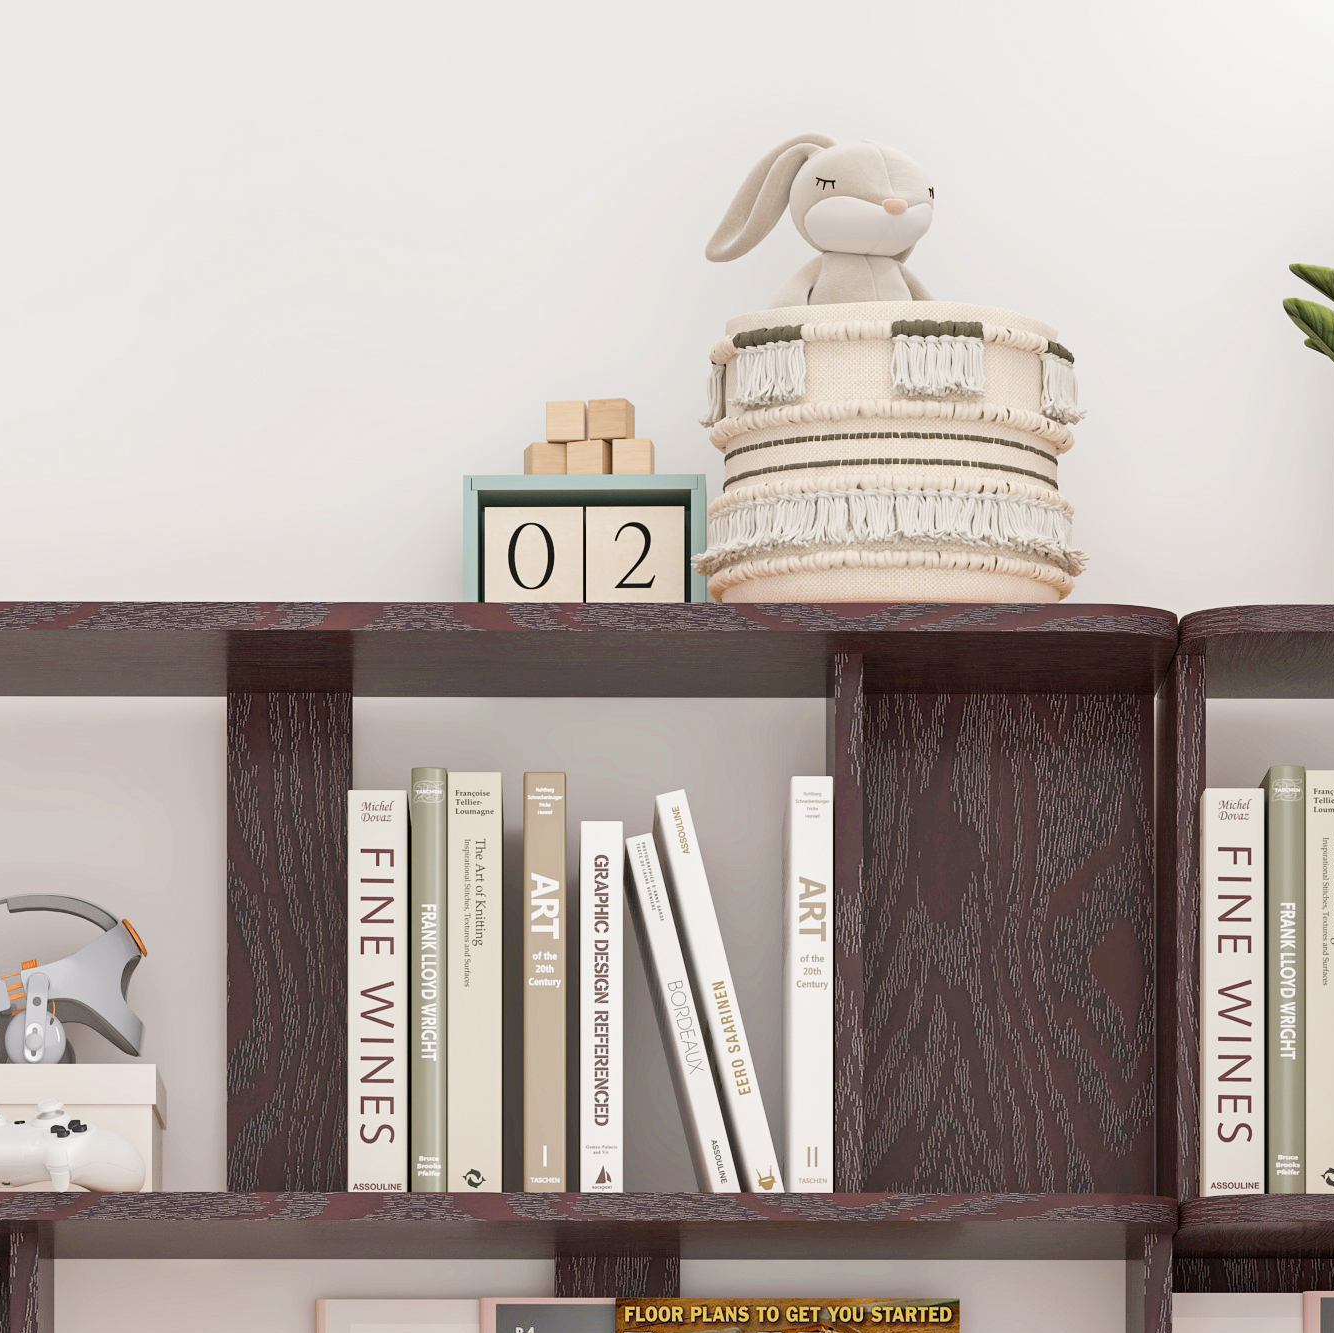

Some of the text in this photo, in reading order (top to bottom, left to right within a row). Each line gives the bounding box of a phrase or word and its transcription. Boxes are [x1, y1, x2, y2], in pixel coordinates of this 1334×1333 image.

[455, 789, 491, 798] Françoise
[360, 800, 395, 812] Michel
[455, 798, 483, 806] Tellier-
[360, 812, 392, 823] Dovaz
[455, 807, 495, 817] Loumagne
[671, 806, 690, 854] ASSOULINE
[471, 837, 487, 947] The Art of Knitting
[462, 839, 472, 988] Inspirational Stitches, Textures and Surfaces
[530, 872, 560, 940] ART
[798, 876, 827, 942] ART
[532, 951, 558, 961] of the
[534, 964, 555, 974] 20th
[421, 904, 438, 1062] FRANK LLOYD WRIGHT
[528, 977, 562, 989] Century
[593, 854, 610, 1127] GRAPHIC DESIGN REFERENCED
[359, 848, 395, 1145] FINE WINES
[1217, 846, 1253, 1143] FINE WINES
[667, 979, 705, 1074] BORDEAUX
[711, 980, 752, 1096] EERO SAARINEN
[416, 1162, 442, 1170] Brooks
[352, 1183, 402, 1191] ASSOULINE
[530, 1176, 561, 1184] TASCHEN
[624, 1307, 952, 1322] FLOOR PLANS TO GET YOU STARTED
